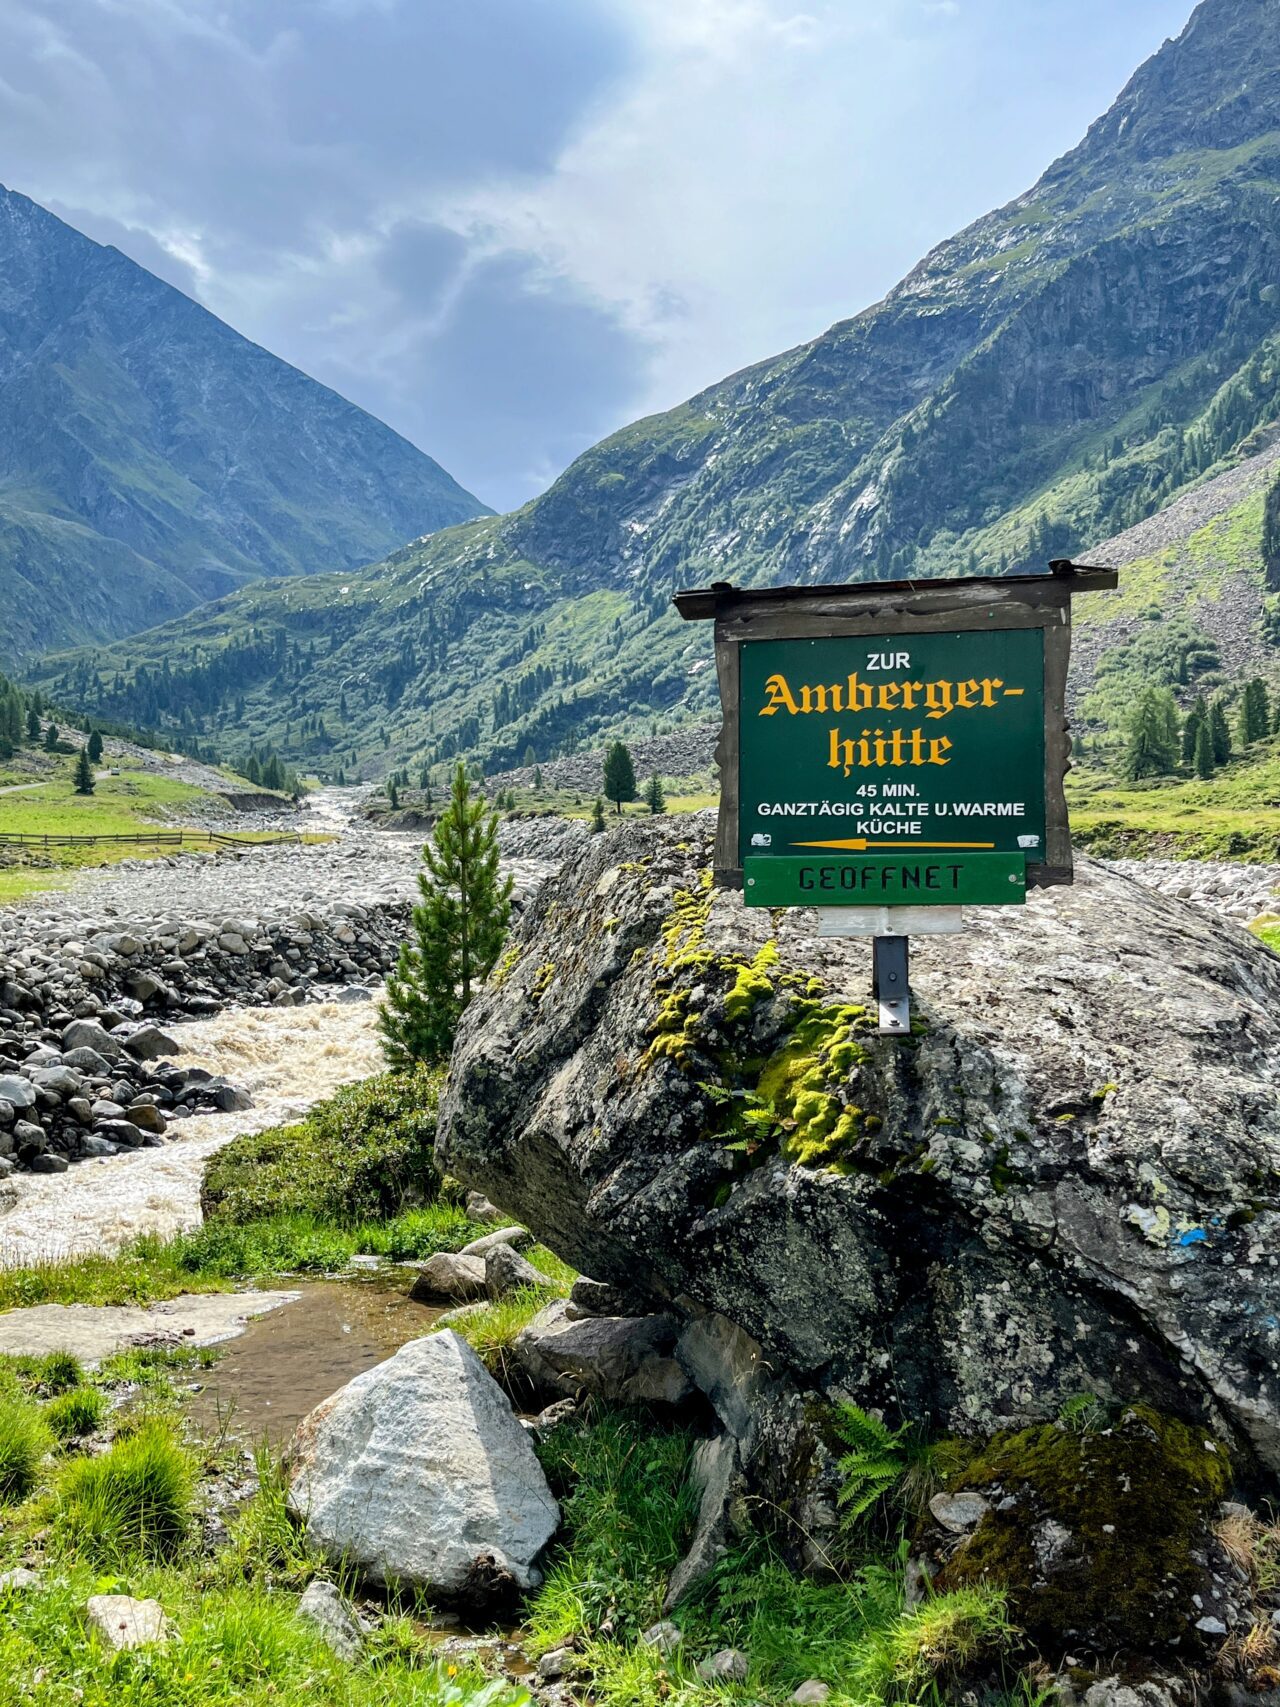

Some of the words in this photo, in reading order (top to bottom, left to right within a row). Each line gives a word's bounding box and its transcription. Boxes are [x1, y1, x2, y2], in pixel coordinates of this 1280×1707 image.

[866, 652, 911, 671] ZUR
[758, 671, 1025, 720] Amberger-
[826, 727, 953, 778] hütte
[856, 784, 877, 797] 45
[882, 784, 920, 797] MIN.
[757, 800, 864, 816] GANZTÄGIG
[869, 803, 929, 816] KALTE
[934, 803, 1026, 816] U.WARME
[856, 818, 922, 834] KÜCHE
